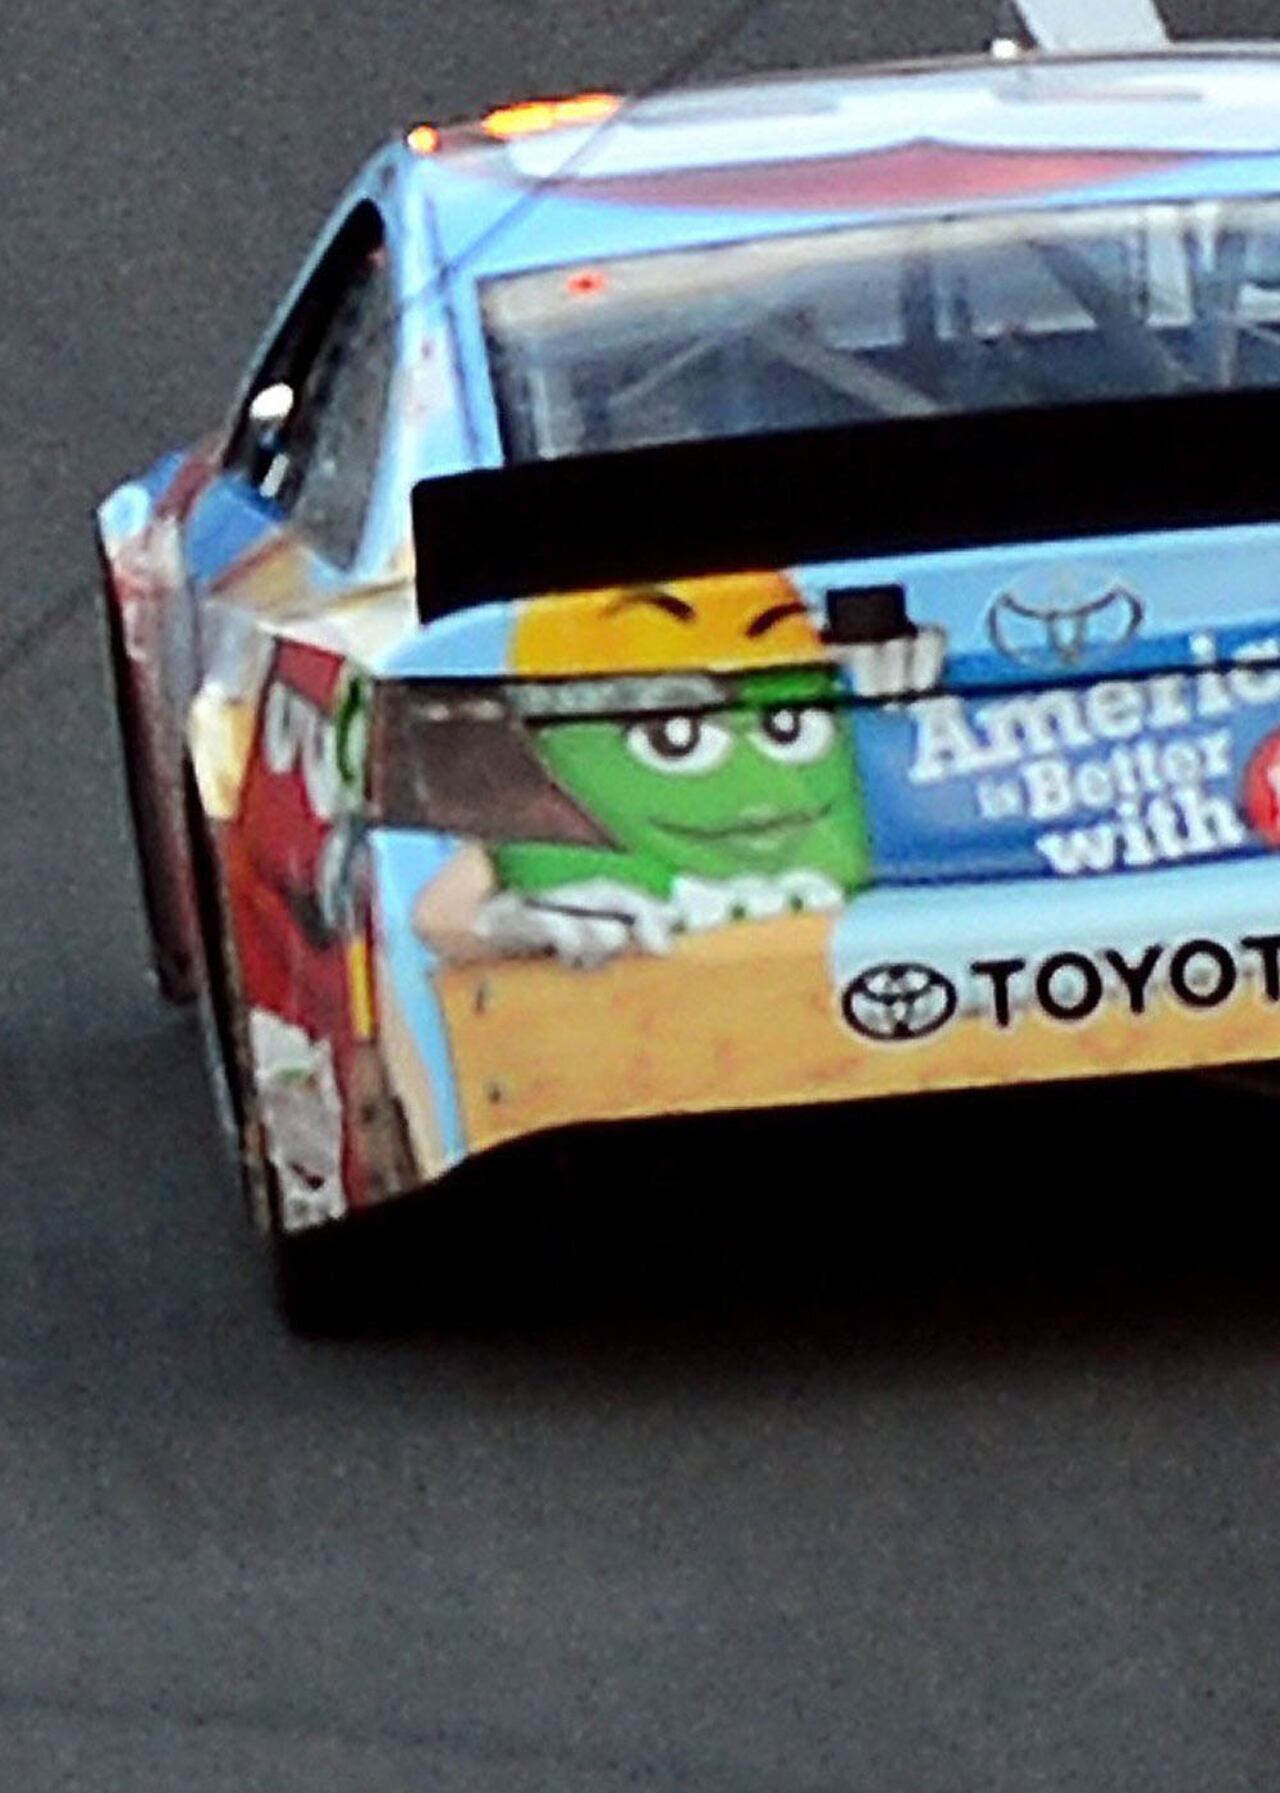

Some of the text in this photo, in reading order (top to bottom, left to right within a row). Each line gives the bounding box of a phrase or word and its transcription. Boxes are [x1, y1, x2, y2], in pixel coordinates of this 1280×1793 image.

[977, 728, 1233, 820] is Better
[1035, 786, 1245, 874] with
